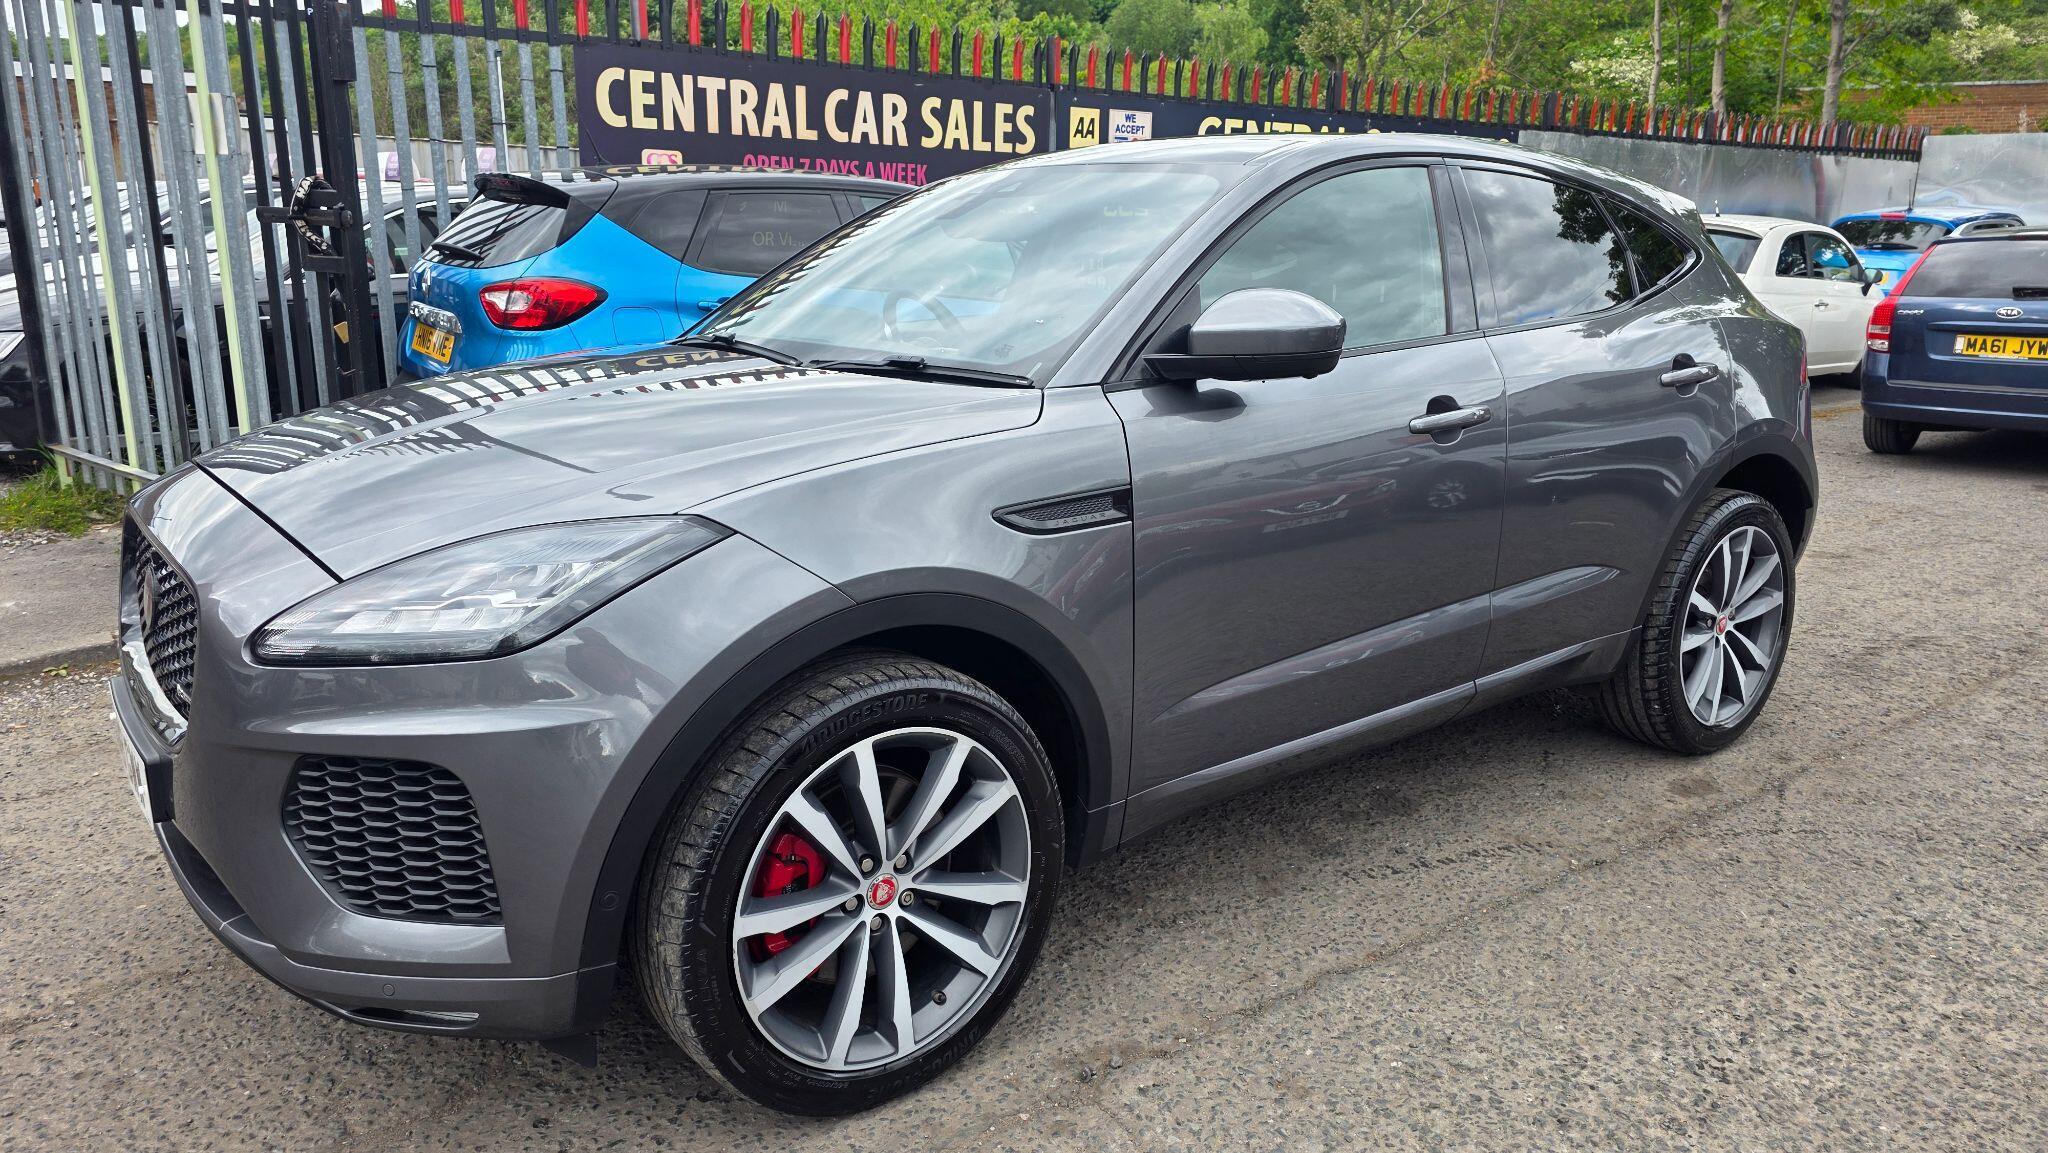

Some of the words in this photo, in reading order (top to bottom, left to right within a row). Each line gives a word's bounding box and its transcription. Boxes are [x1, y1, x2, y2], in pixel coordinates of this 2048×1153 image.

[595, 67, 818, 140] CENTRAL
[824, 88, 908, 147] CAR
[921, 96, 1036, 154] SALES
[1125, 113, 1137, 123] WE
[1073, 117, 1095, 139] AA
[1115, 124, 1145, 135] ACCEPT
[865, 161, 875, 178] A
[879, 162, 928, 186] WEEK
[1965, 337, 2007, 353] MA61
[2012, 339, 2048, 356] JYW
[1055, 512, 1107, 526] JAGUAR
